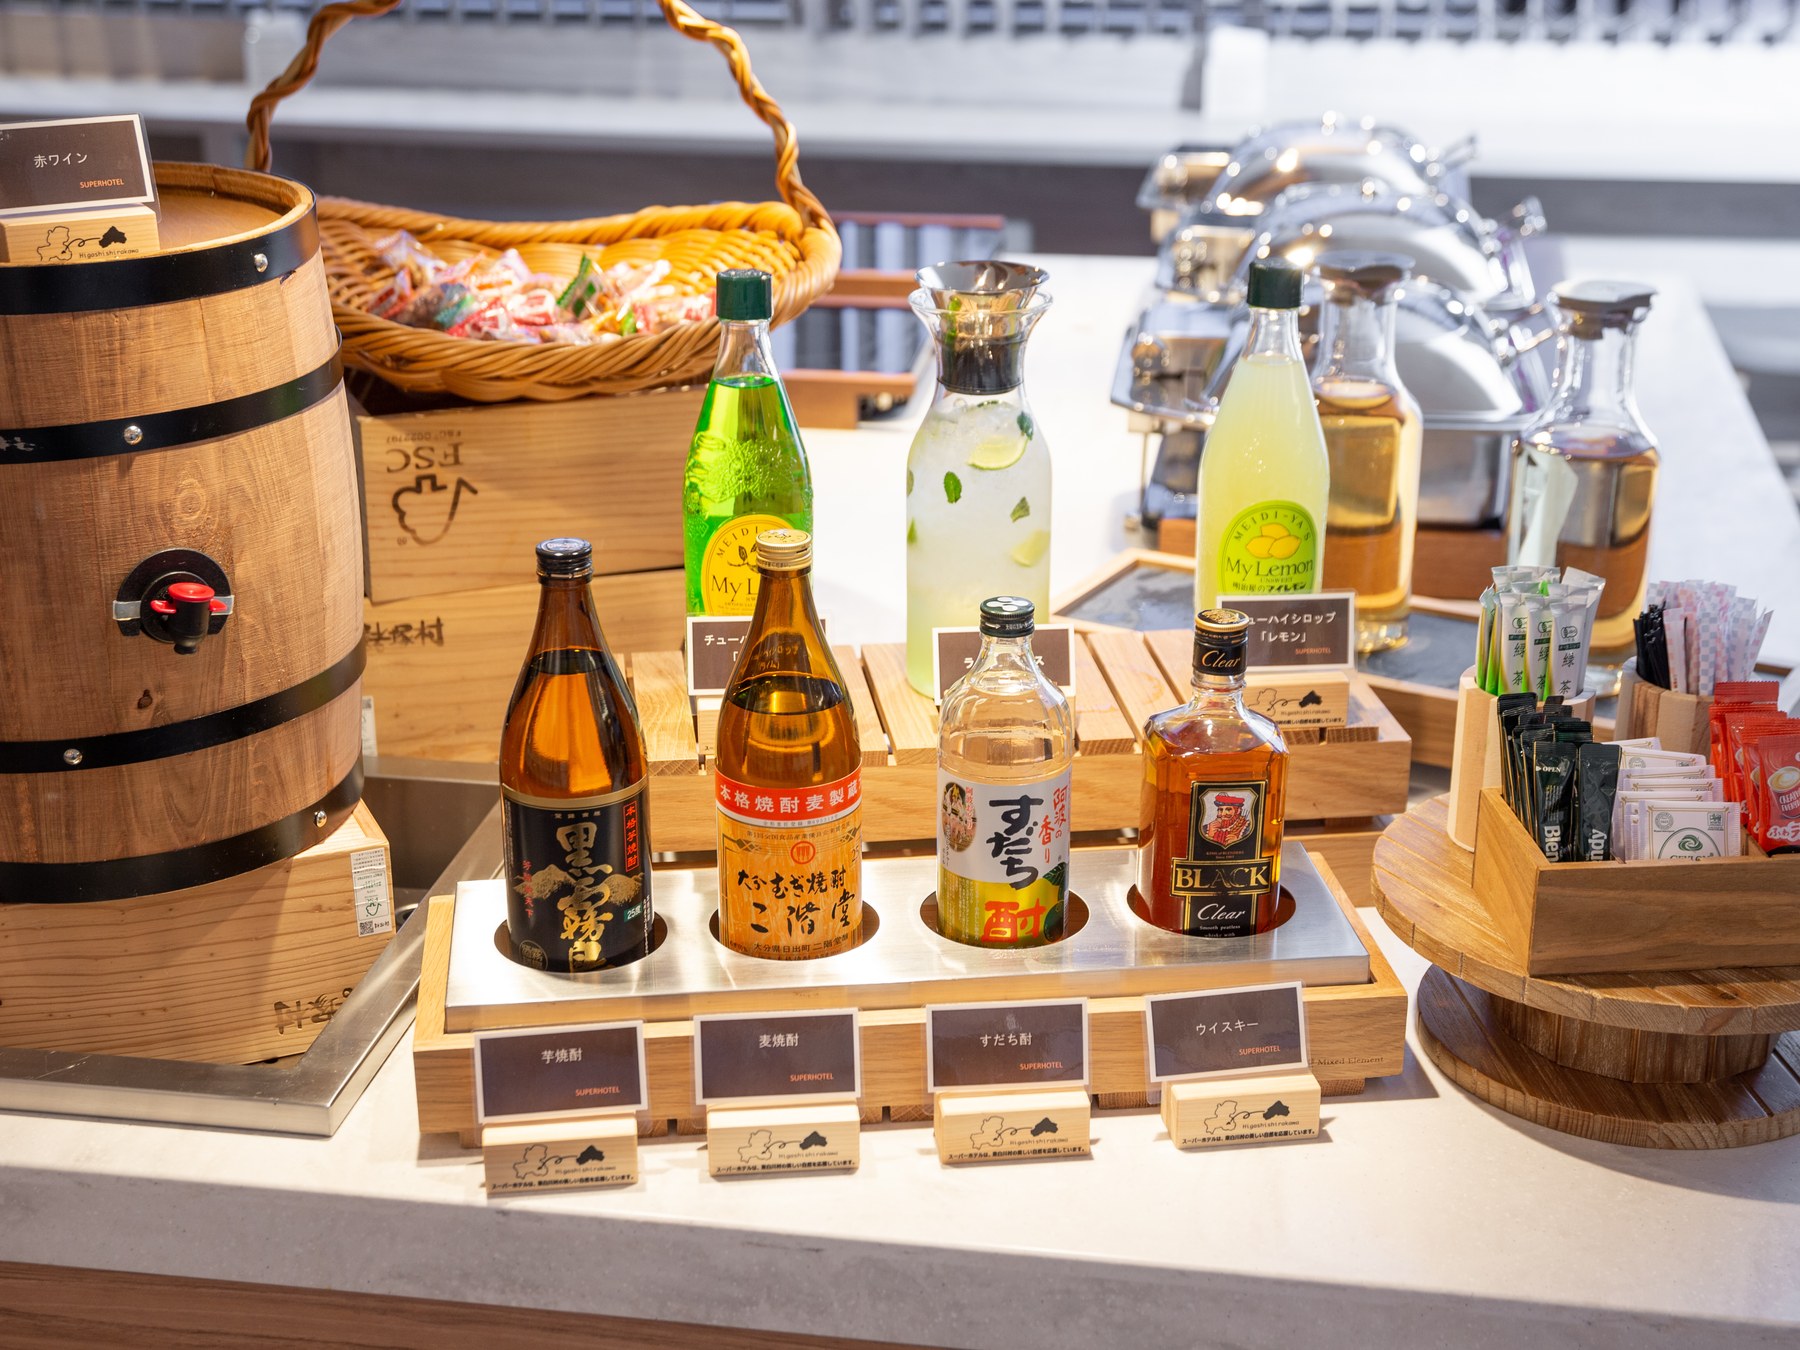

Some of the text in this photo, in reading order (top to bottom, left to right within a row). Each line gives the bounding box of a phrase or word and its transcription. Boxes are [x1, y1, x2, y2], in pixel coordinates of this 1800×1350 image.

[34, 153, 88, 168] 赤ワイン
[79, 178, 125, 189] SUPERHOTEL
[79, 248, 139, 259] Higashishirakawa
[385, 442, 464, 473] FSC
[1226, 556, 1314, 582] My Lemon
[711, 575, 742, 602] My
[1248, 612, 1336, 625] ューハイシロップ
[1261, 631, 1306, 643] 「レモン」
[1202, 650, 1240, 667] Clear
[625, 805, 639, 867] 本格芋焼酎
[1544, 826, 1561, 861] Blen
[1176, 866, 1269, 889] BLACK
[627, 904, 642, 920] 25度
[751, 889, 855, 937] 二階堂
[1197, 903, 1246, 920] Clear
[1196, 1019, 1259, 1036] ウイスキー
[759, 1032, 799, 1049] 麦焼酎
[980, 1032, 1032, 1048] すだち酎
[541, 1047, 583, 1064] 芋焼酎
[1239, 1045, 1281, 1056] SUPERHOTEL
[1019, 1061, 1064, 1071] SUPERHOTEL
[1348, 1056, 1384, 1064] Element
[789, 1072, 834, 1082] SUPERHOTEL
[575, 1085, 620, 1097] SUPERHOTEL
[1242, 1120, 1300, 1131] Higashishirakawa
